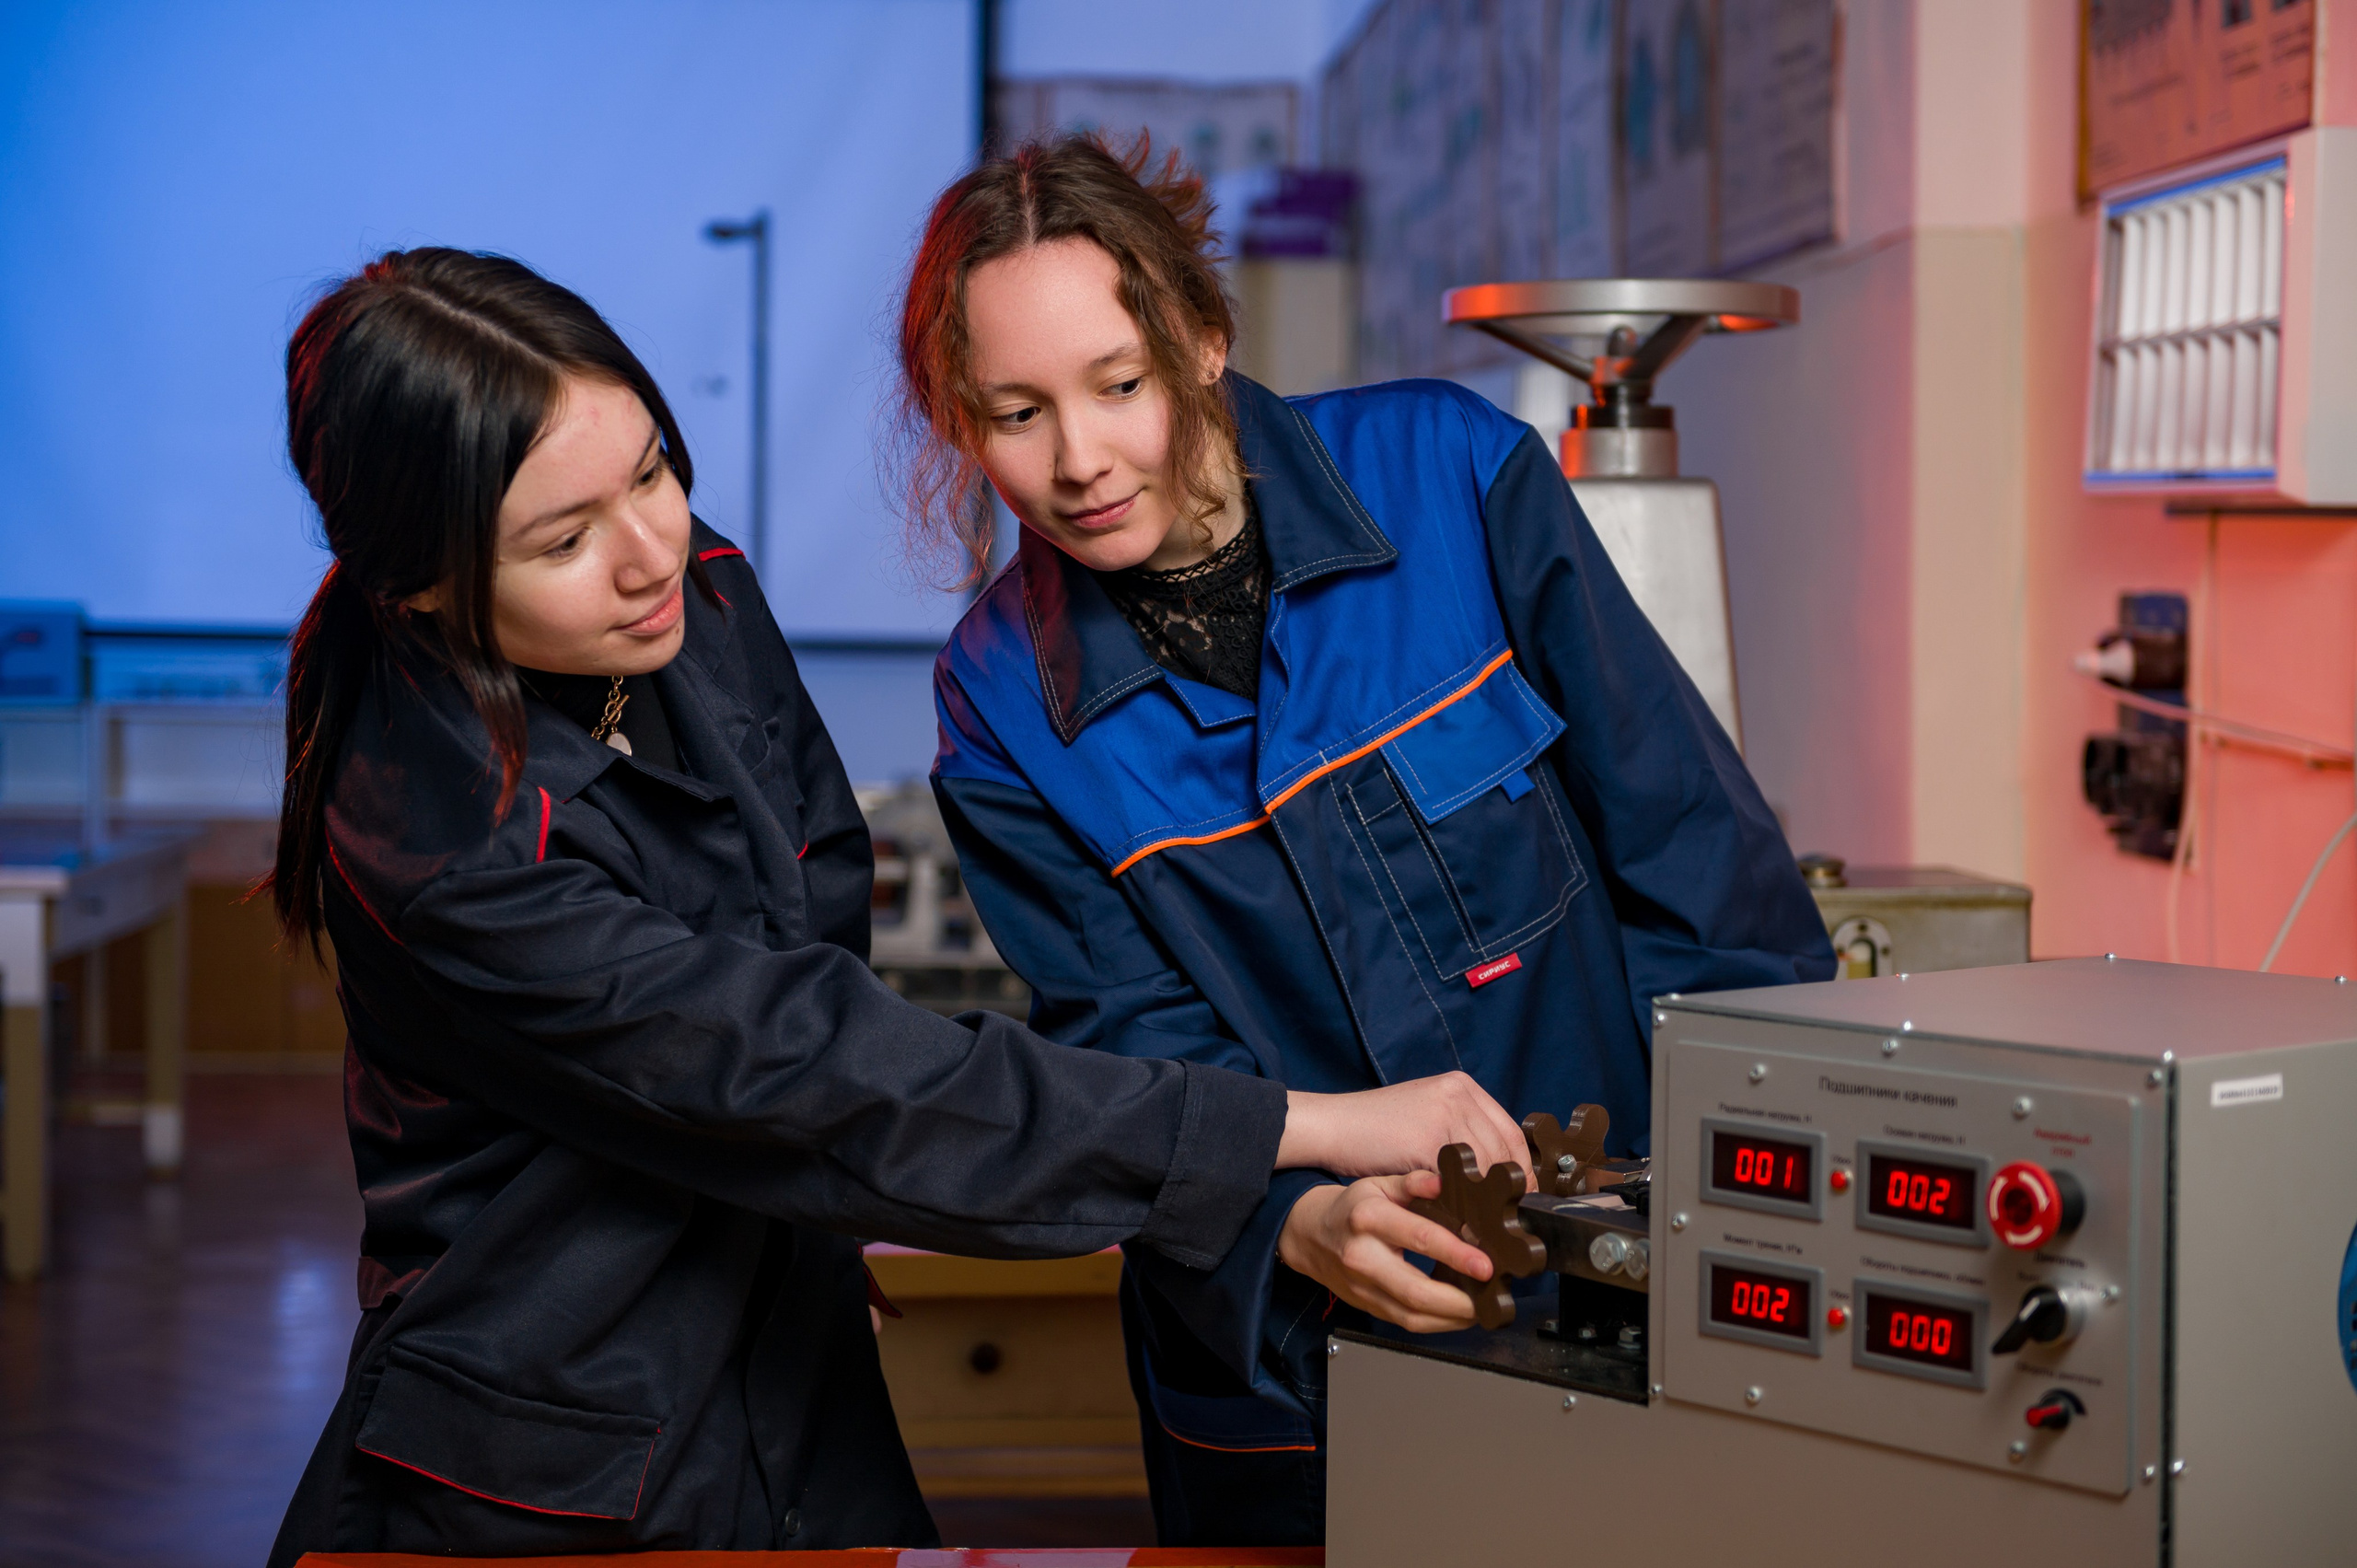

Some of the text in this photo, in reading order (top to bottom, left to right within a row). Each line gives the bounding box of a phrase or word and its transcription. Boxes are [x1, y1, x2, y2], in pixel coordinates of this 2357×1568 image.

[1478, 960, 1511, 980] СИРИУС
[1818, 1076, 1958, 1109] Подшипники качения
[1735, 1148, 1794, 1190] 001
[1887, 1170, 1951, 1215] 002
[1731, 1282, 1790, 1322] 002
[1889, 1312, 1953, 1355] 000
